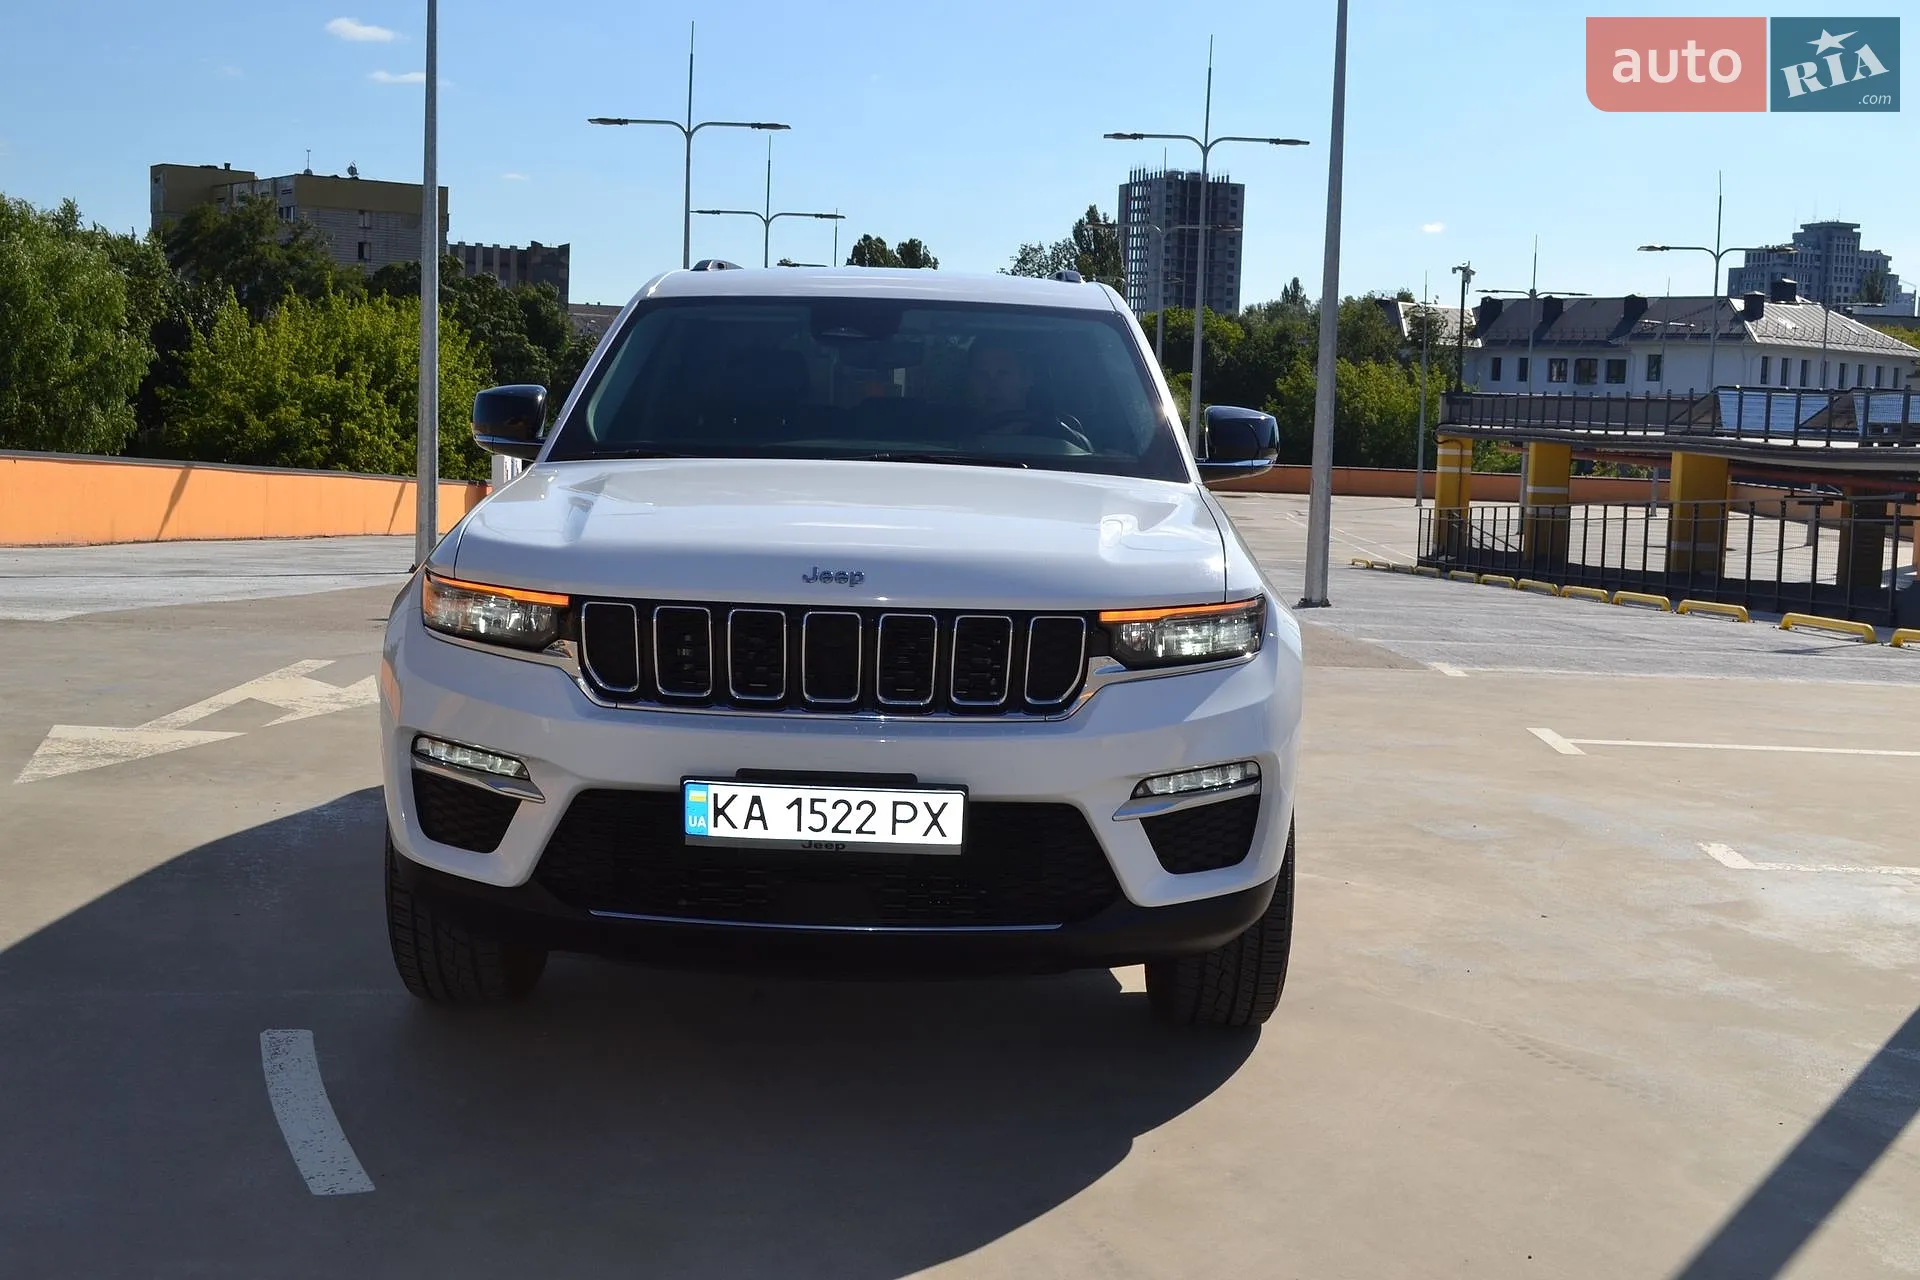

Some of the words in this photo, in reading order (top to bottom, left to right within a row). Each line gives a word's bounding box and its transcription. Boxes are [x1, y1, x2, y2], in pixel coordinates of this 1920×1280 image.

[802, 566, 864, 587] Jeep
[688, 815, 707, 828] UA
[713, 793, 768, 830] KA
[786, 798, 876, 834] 1522
[892, 801, 948, 837] PX
[801, 840, 846, 851] Jeep
